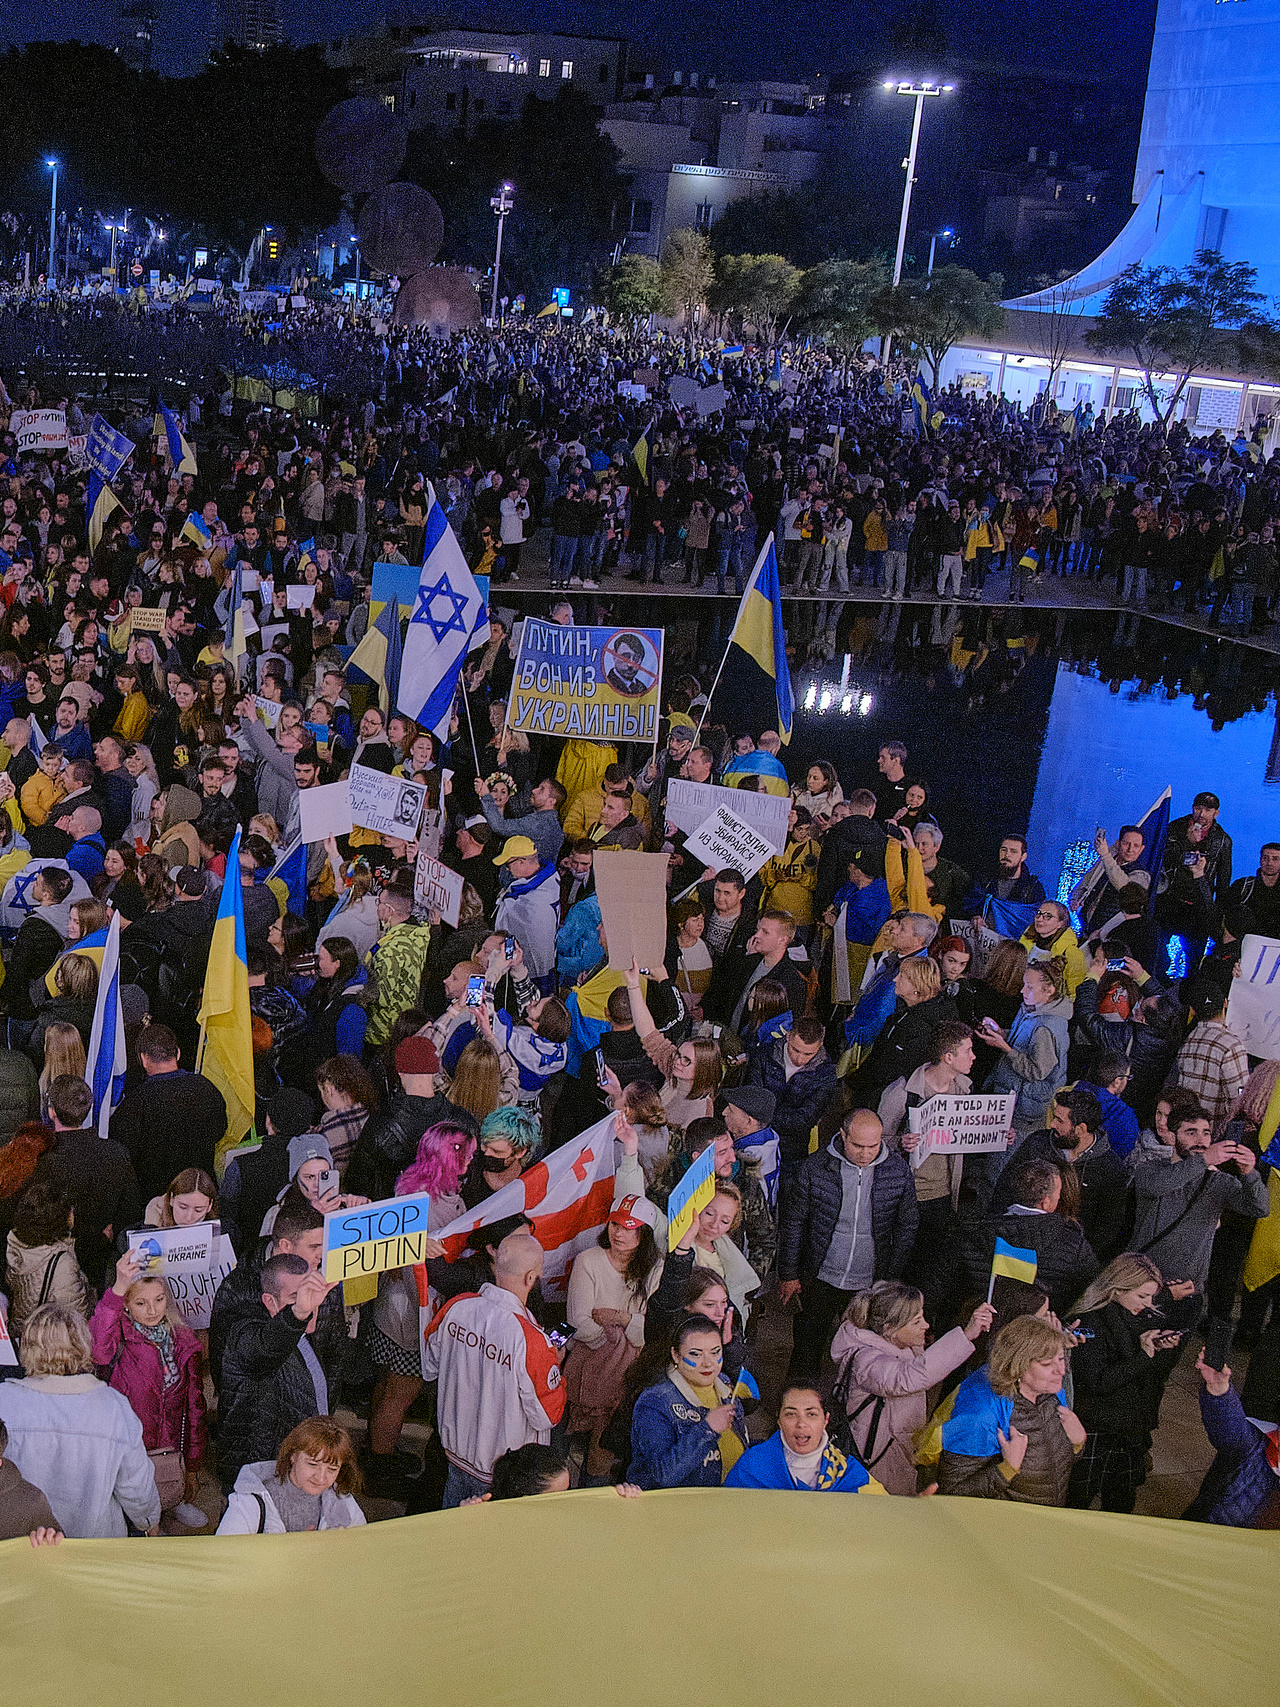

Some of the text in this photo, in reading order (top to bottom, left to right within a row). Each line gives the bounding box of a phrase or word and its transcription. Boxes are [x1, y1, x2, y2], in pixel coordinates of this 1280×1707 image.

[18, 432, 41, 447] STOP
[527, 624, 599, 658] ПУТИН,
[520, 661, 596, 697] ВОН ИЗ
[514, 695, 653, 738] УКРАИНЫ!
[698, 830, 713, 847] ИЗ
[714, 826, 756, 864] УБИРАЙСЯ
[716, 807, 747, 837] ФАШИСТ
[743, 828, 769, 856] ПУТИН
[417, 853, 446, 882] STOP
[415, 872, 451, 913] PUTIN
[947, 1116, 963, 1127] AN
[964, 1113, 1007, 1126] ASSHOLE
[954, 1100, 983, 1112] TOLD
[987, 1099, 1007, 1112] ME
[959, 1130, 981, 1145] MOM
[340, 1206, 421, 1248] STOP
[167, 1250, 207, 1262] UKRAINE
[342, 1234, 422, 1279] PUTIN
[447, 1321, 511, 1371] GEORGIA
